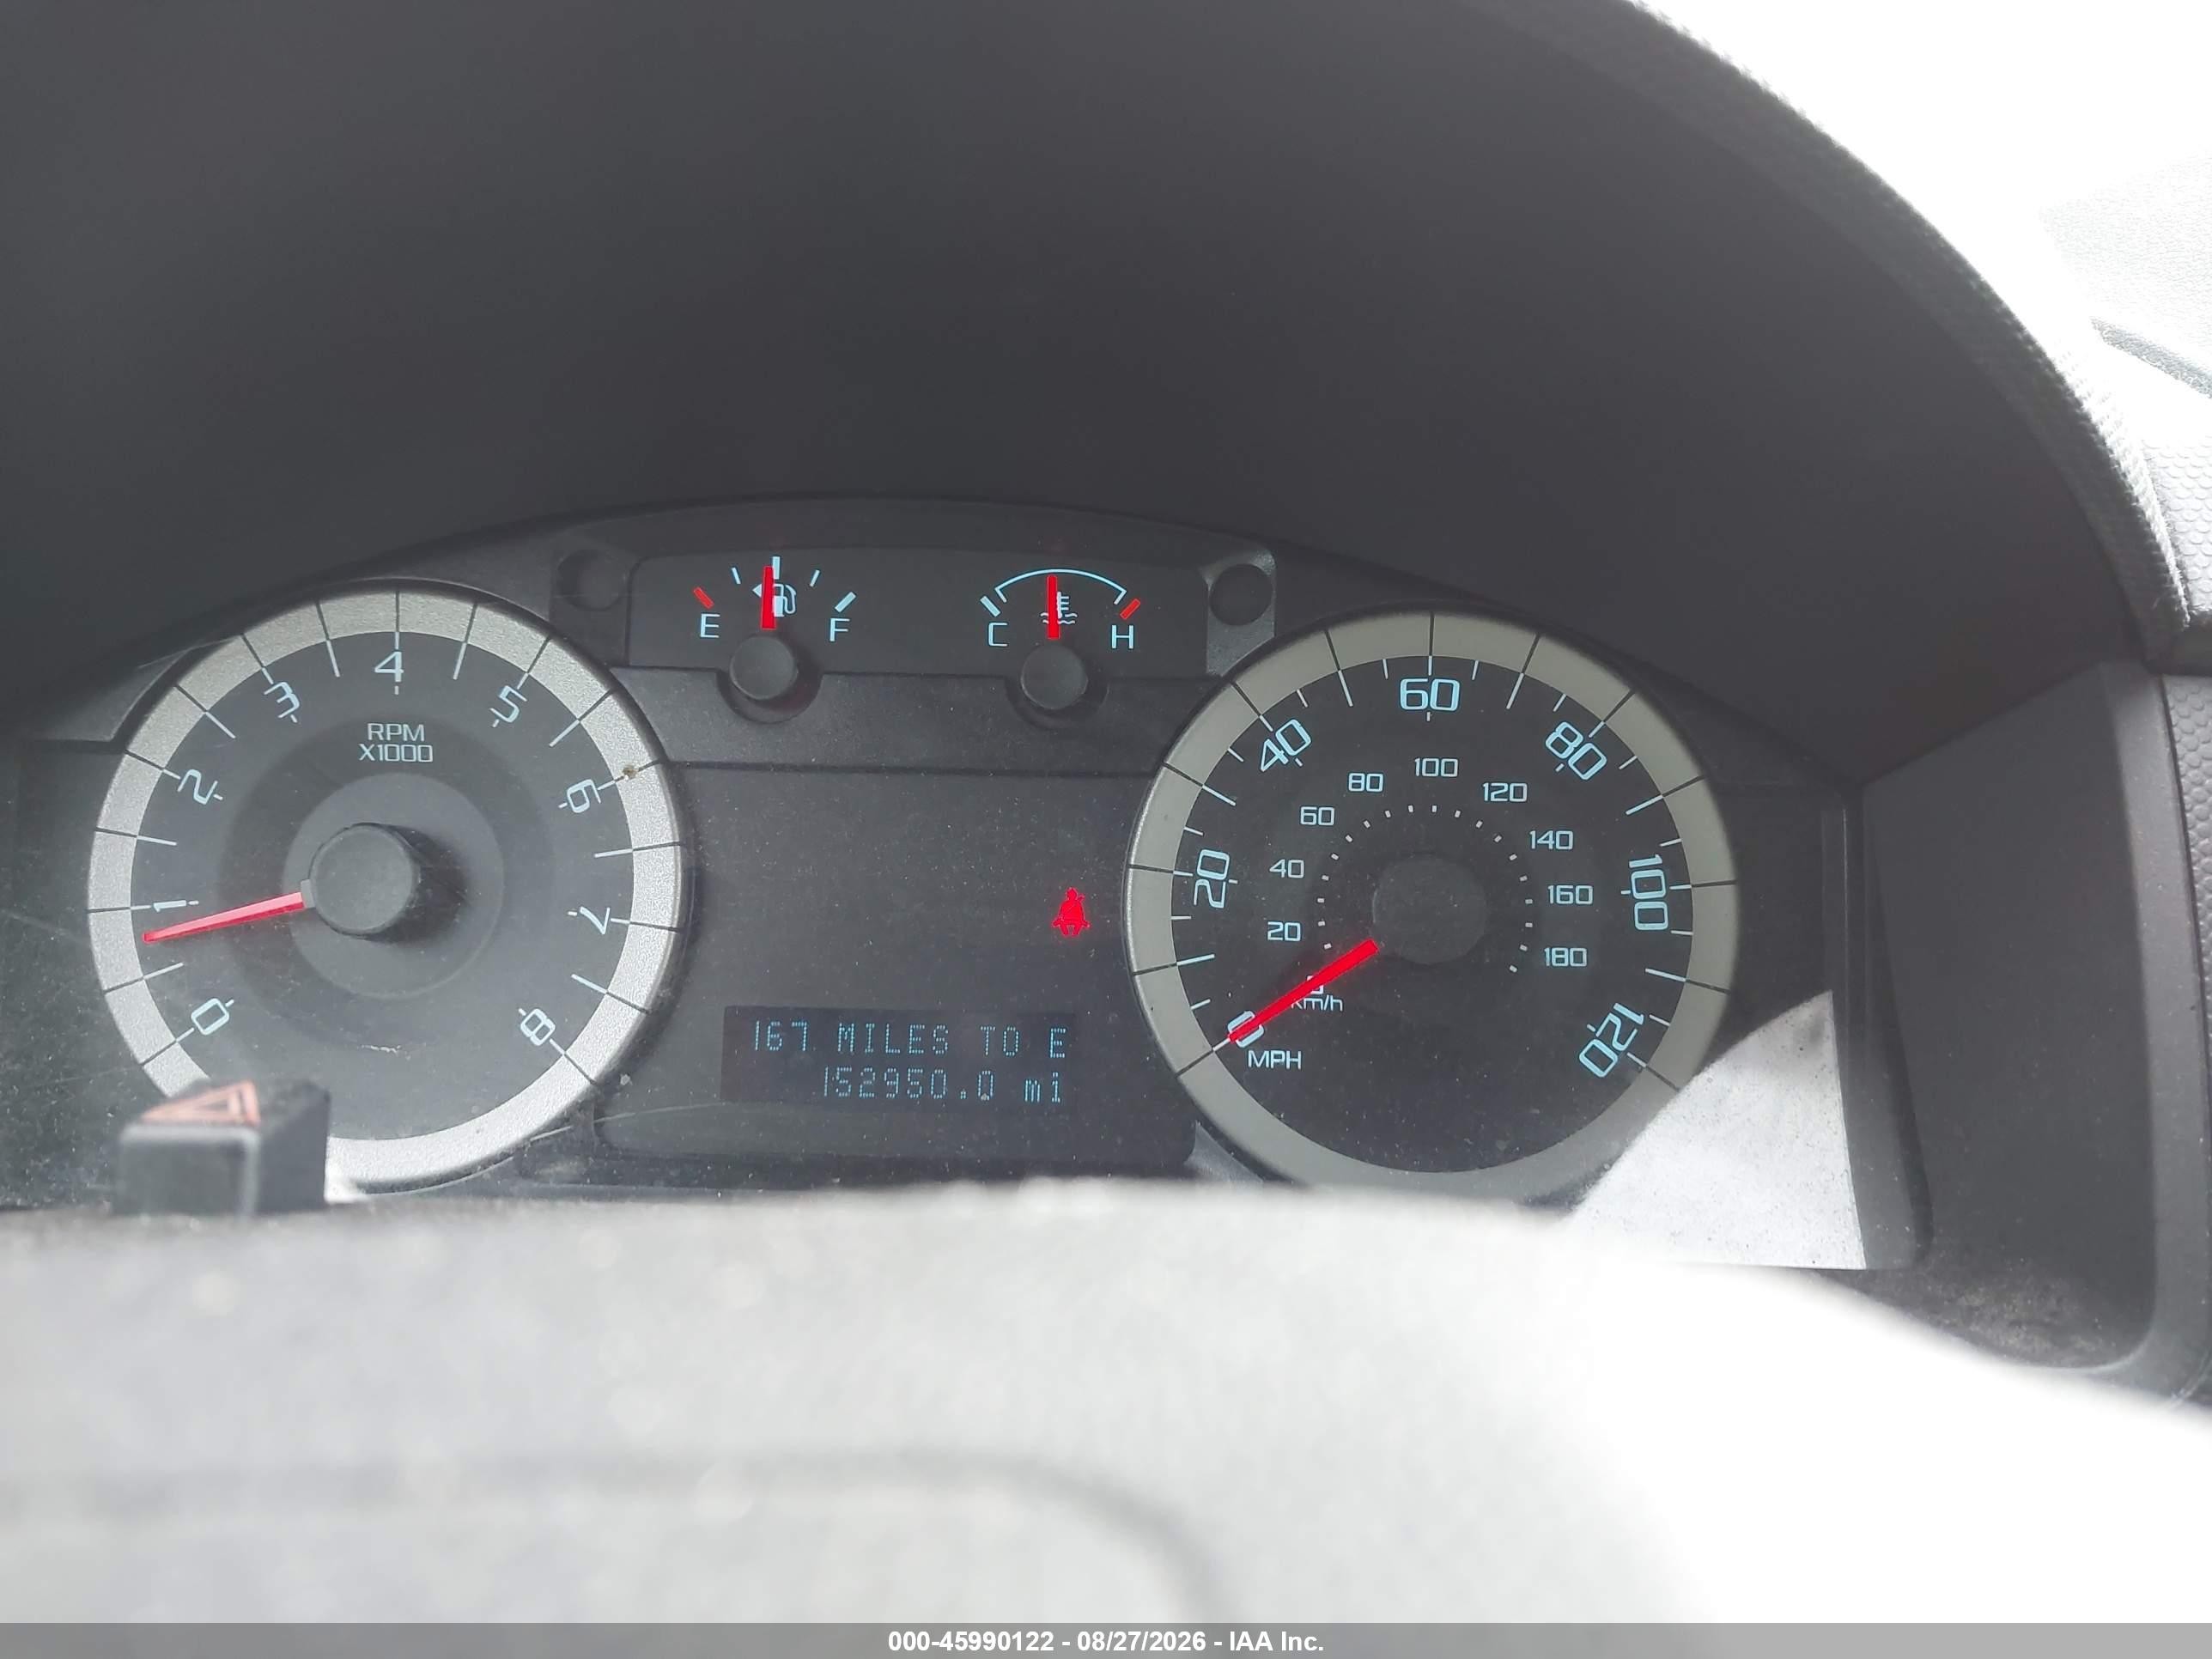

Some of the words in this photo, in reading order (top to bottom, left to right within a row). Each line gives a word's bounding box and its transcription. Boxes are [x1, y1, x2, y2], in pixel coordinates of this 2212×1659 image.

[699, 613, 720, 639] E
[829, 617, 849, 642] F
[988, 622, 1008, 647] C
[1111, 625, 1134, 649] H
[374, 651, 404, 681] 4
[264, 681, 301, 720] 3
[490, 685, 527, 723] 5
[1399, 678, 1461, 712] 60
[367, 723, 425, 741] RPM
[358, 743, 434, 763] X1000
[1259, 719, 1312, 772] 40
[1545, 721, 1607, 781] 80
[1413, 757, 1460, 777] 100
[177, 769, 216, 805] 2
[1347, 773, 1384, 793] 80
[1482, 782, 1528, 803] 120
[565, 779, 601, 814] 6
[1300, 806, 1335, 827] 60
[1529, 830, 1574, 850] 140
[1194, 849, 1231, 908] 20
[1270, 859, 1305, 878] 40
[1547, 884, 1594, 906] 160
[1629, 854, 1668, 931] 100
[153, 900, 188, 913] 1
[579, 905, 611, 935] 7
[1267, 921, 1302, 942] 20
[1544, 947, 1588, 968] 180
[191, 998, 229, 1035] 0
[520, 1009, 556, 1047] 8
[755, 1020, 808, 1052] 167
[837, 1022, 949, 1055] MILES
[981, 1025, 1019, 1057] TO
[1049, 1027, 1066, 1059] E
[1579, 1003, 1644, 1078] 120
[1248, 1049, 1302, 1070] MPH
[823, 1066, 996, 1101] 152950.0
[1024, 1071, 1061, 1103] mi
